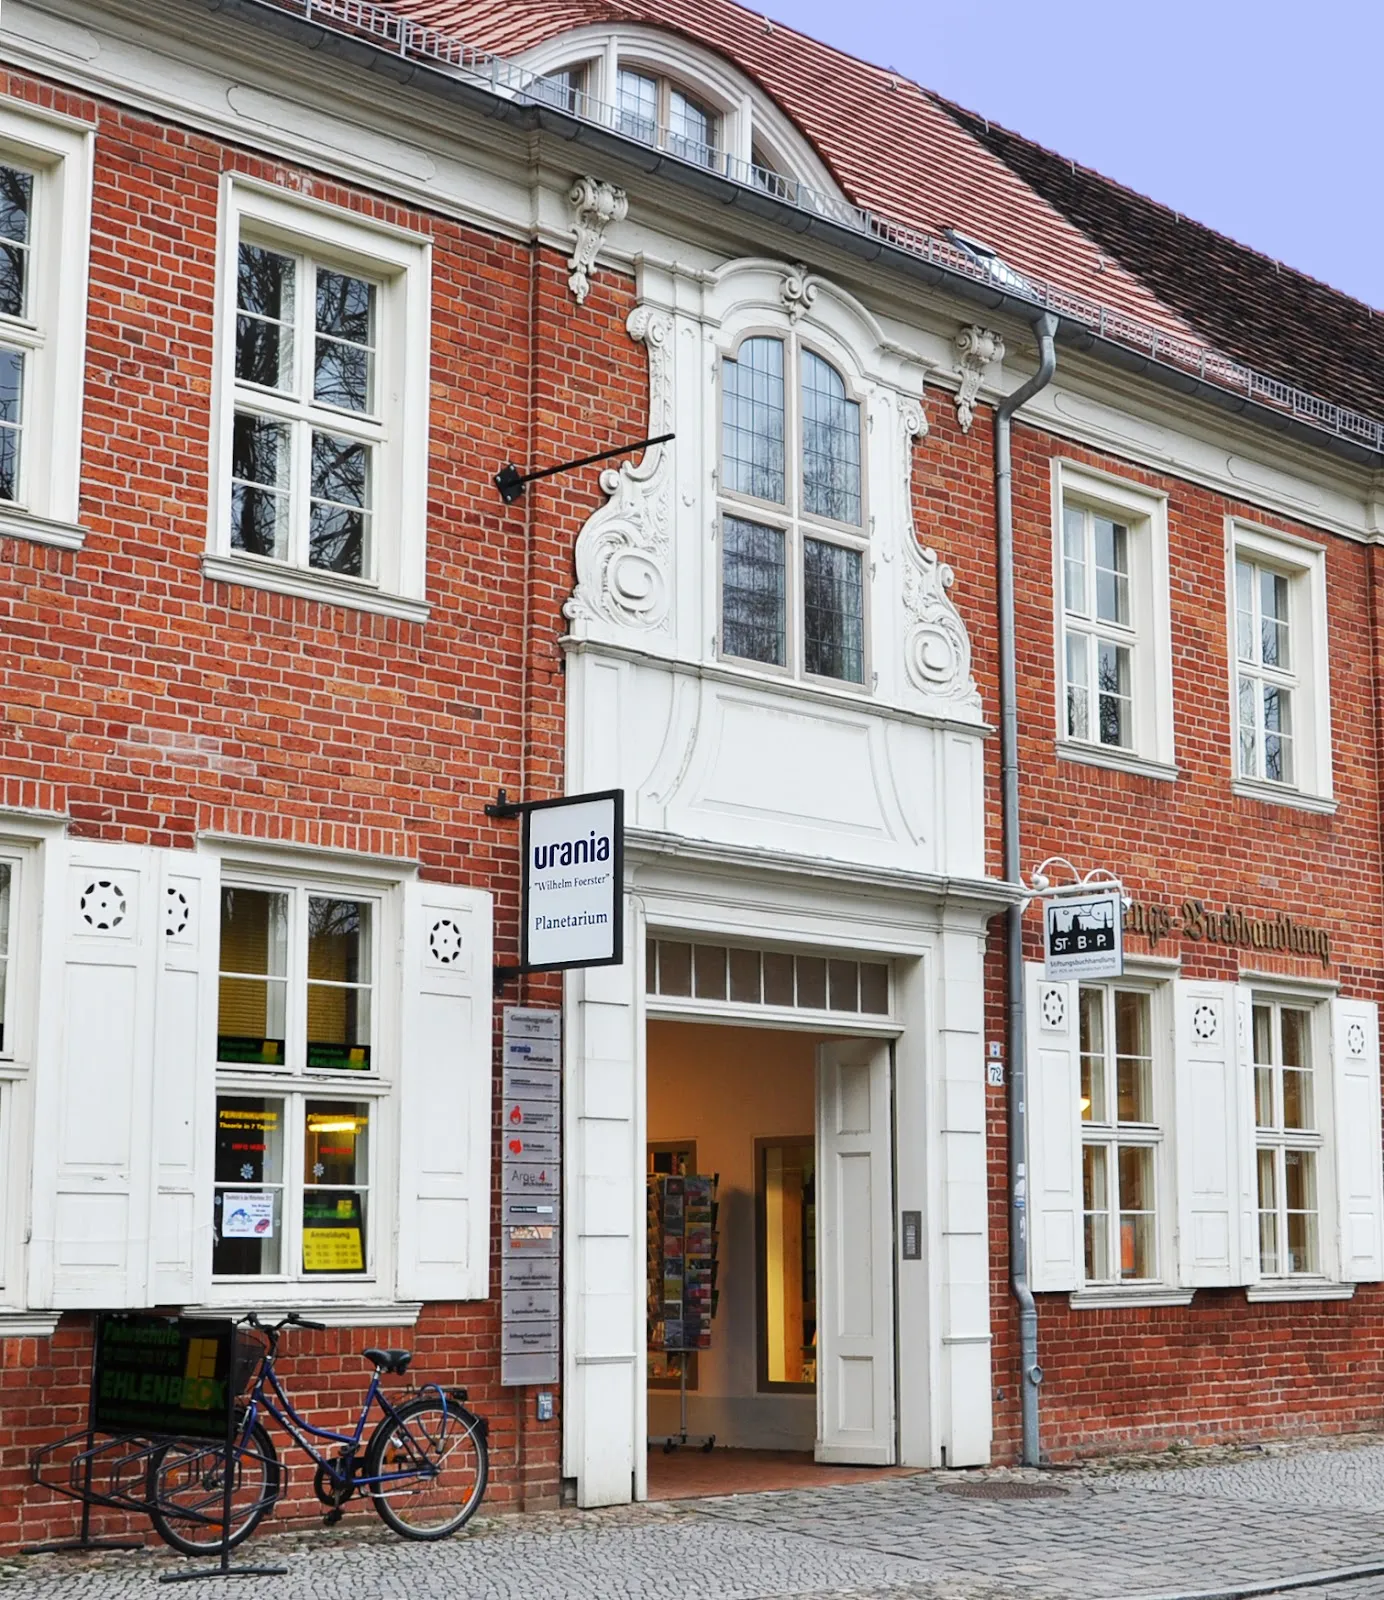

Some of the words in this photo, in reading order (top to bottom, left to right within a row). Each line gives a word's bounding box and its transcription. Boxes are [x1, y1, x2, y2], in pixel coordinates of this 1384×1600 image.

[534, 830, 610, 870] urania
[534, 877, 573, 892] "Wilhelm
[573, 873, 610, 888] Foerster"
[535, 911, 608, 931] Planetarium
[990, 1066, 1002, 1083] 72
[511, 1169, 536, 1182] Arge
[538, 1169, 546, 1183] 4
[310, 1230, 351, 1240] Anmeldung
